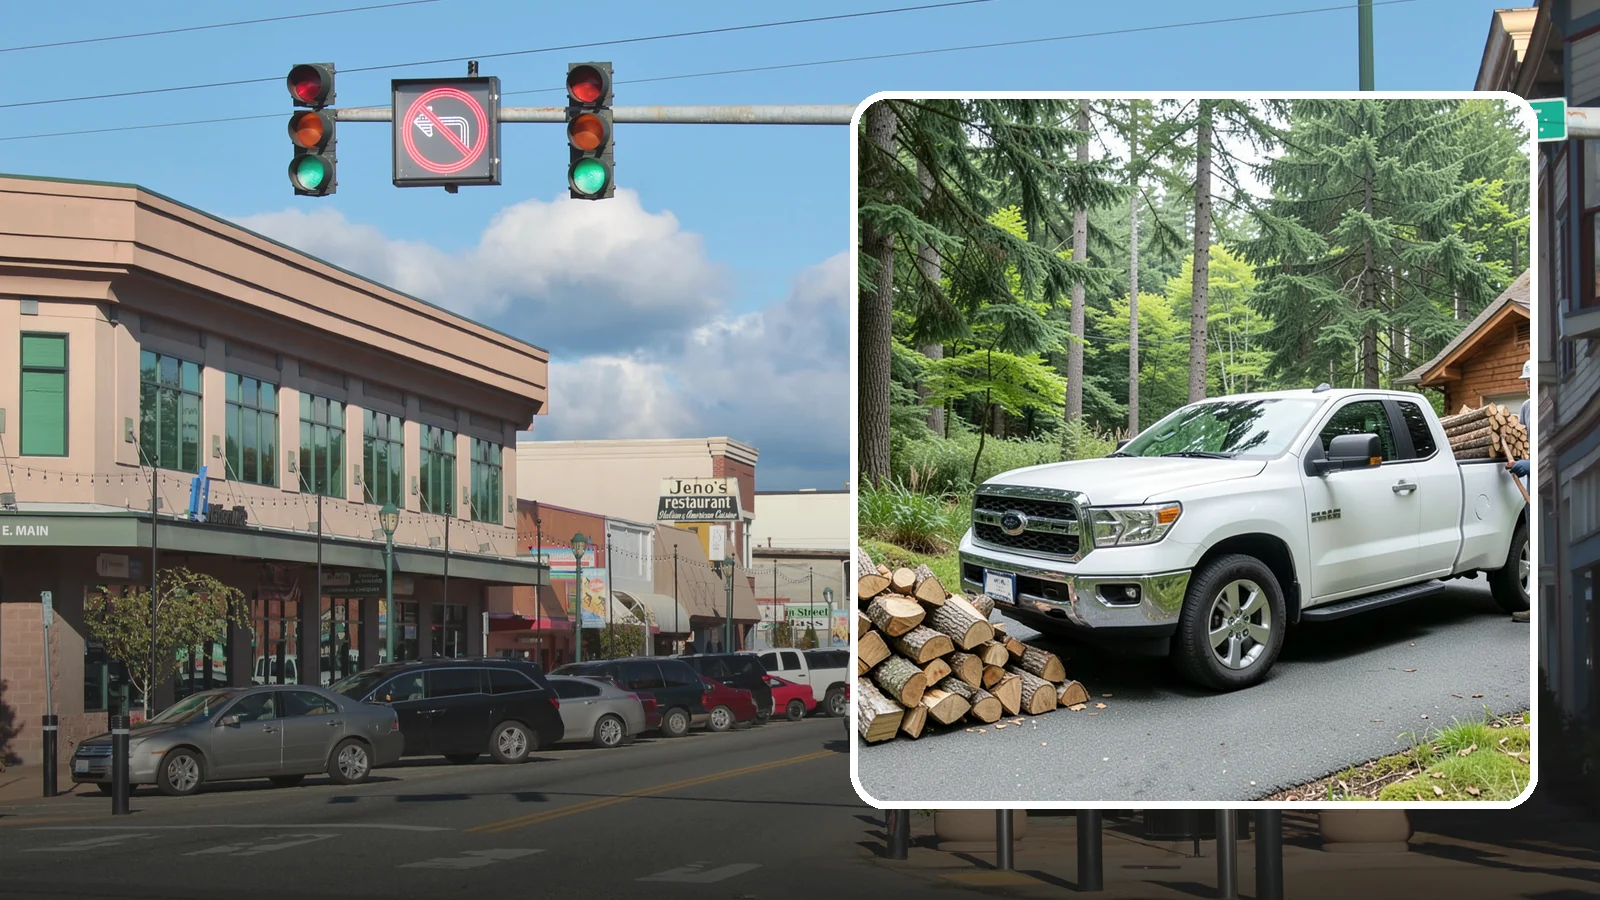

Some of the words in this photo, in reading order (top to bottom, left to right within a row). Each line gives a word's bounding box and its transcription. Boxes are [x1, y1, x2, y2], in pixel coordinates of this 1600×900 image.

[670, 480, 727, 494] Jeno's
[665, 496, 731, 509] restaurant
[659, 510, 681, 519] Italian
[686, 509, 714, 519] American
[715, 509, 737, 519] Cuisine
[2, 525, 13, 536] E.
[15, 525, 49, 536] MAIN
[785, 608, 795, 616] in
[797, 607, 828, 617] Street
[789, 619, 824, 627] lass
